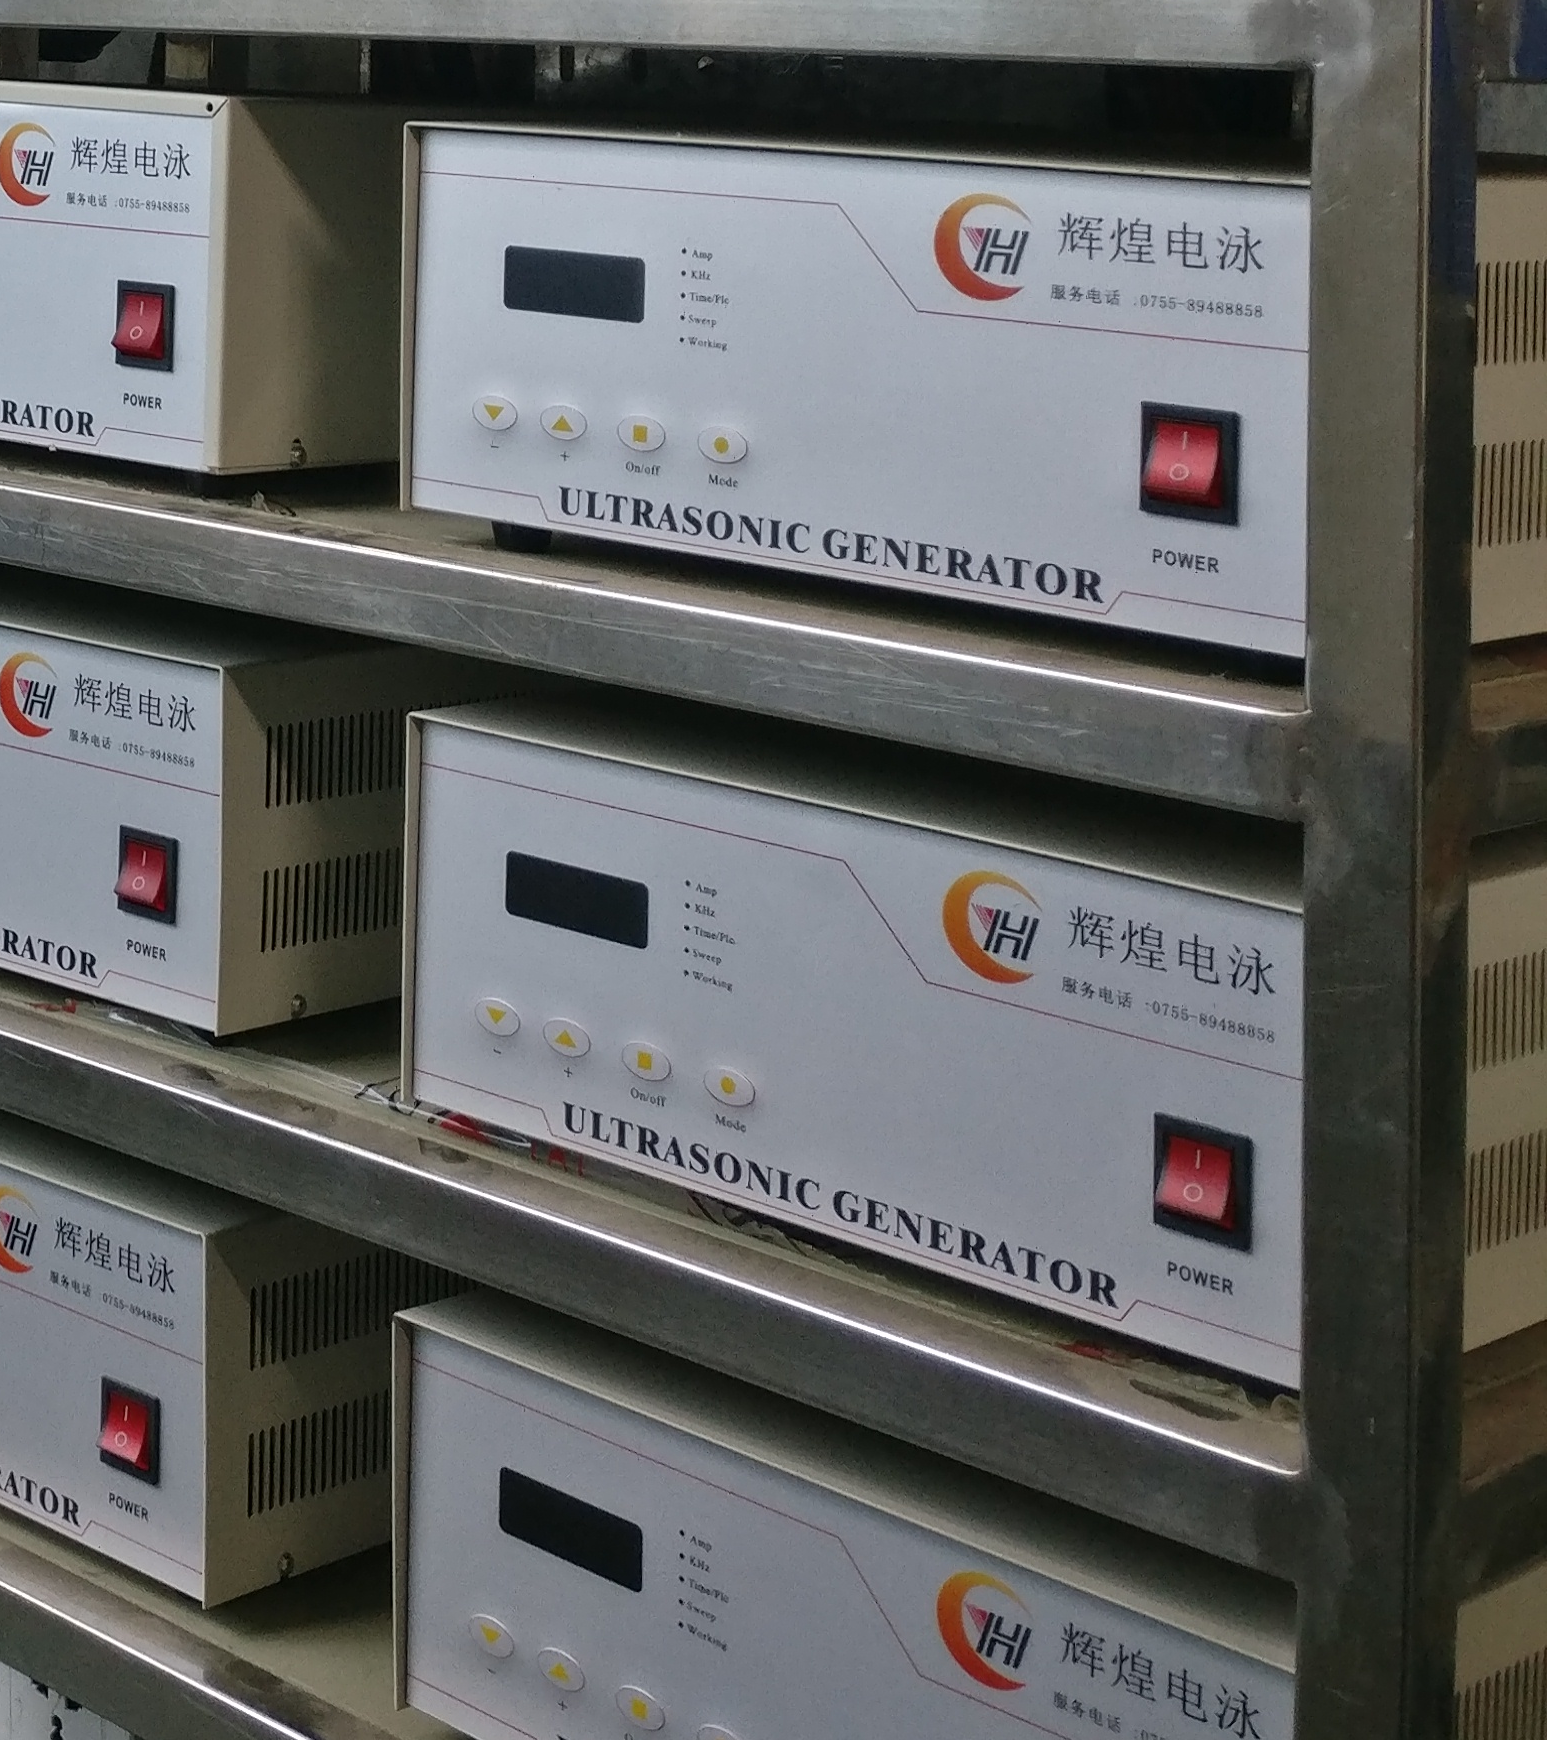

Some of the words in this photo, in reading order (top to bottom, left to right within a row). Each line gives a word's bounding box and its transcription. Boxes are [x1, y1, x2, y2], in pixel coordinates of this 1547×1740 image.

[70, 134, 191, 183] 辉煌电泳
[692, 248, 713, 263] Amp
[1057, 210, 1264, 276] 辉煌电泳
[691, 268, 711, 282] KHz
[1050, 281, 1120, 306] 服务电话
[688, 335, 727, 352] Working
[123, 393, 161, 409] POWER
[626, 459, 661, 477] On/off
[709, 471, 738, 489] Mode
[559, 485, 809, 555] ULTRASONIC
[823, 527, 1103, 603] GENERATOR
[1152, 549, 1219, 574] POWER
[73, 671, 197, 736] 辉煌电泳
[696, 882, 717, 900] Amp
[695, 903, 715, 919] KHz
[127, 939, 166, 962] POWER
[1067, 902, 1277, 1002] 辉煌电泳
[693, 968, 733, 992] Working
[1061, 975, 1132, 1010] 服务电话
[630, 1086, 666, 1109] On/off
[715, 1111, 745, 1134] Mode
[563, 1101, 819, 1212] ULTRASONIC
[833, 1187, 1120, 1309] GENERATOR
[54, 1214, 175, 1298] 辉煌电泳
[1166, 1260, 1234, 1296] POWER
[109, 1492, 148, 1521] POWER
[1061, 1622, 1260, 1740] 辉煌电泳
[1053, 1692, 1121, 1733] 服务电话
